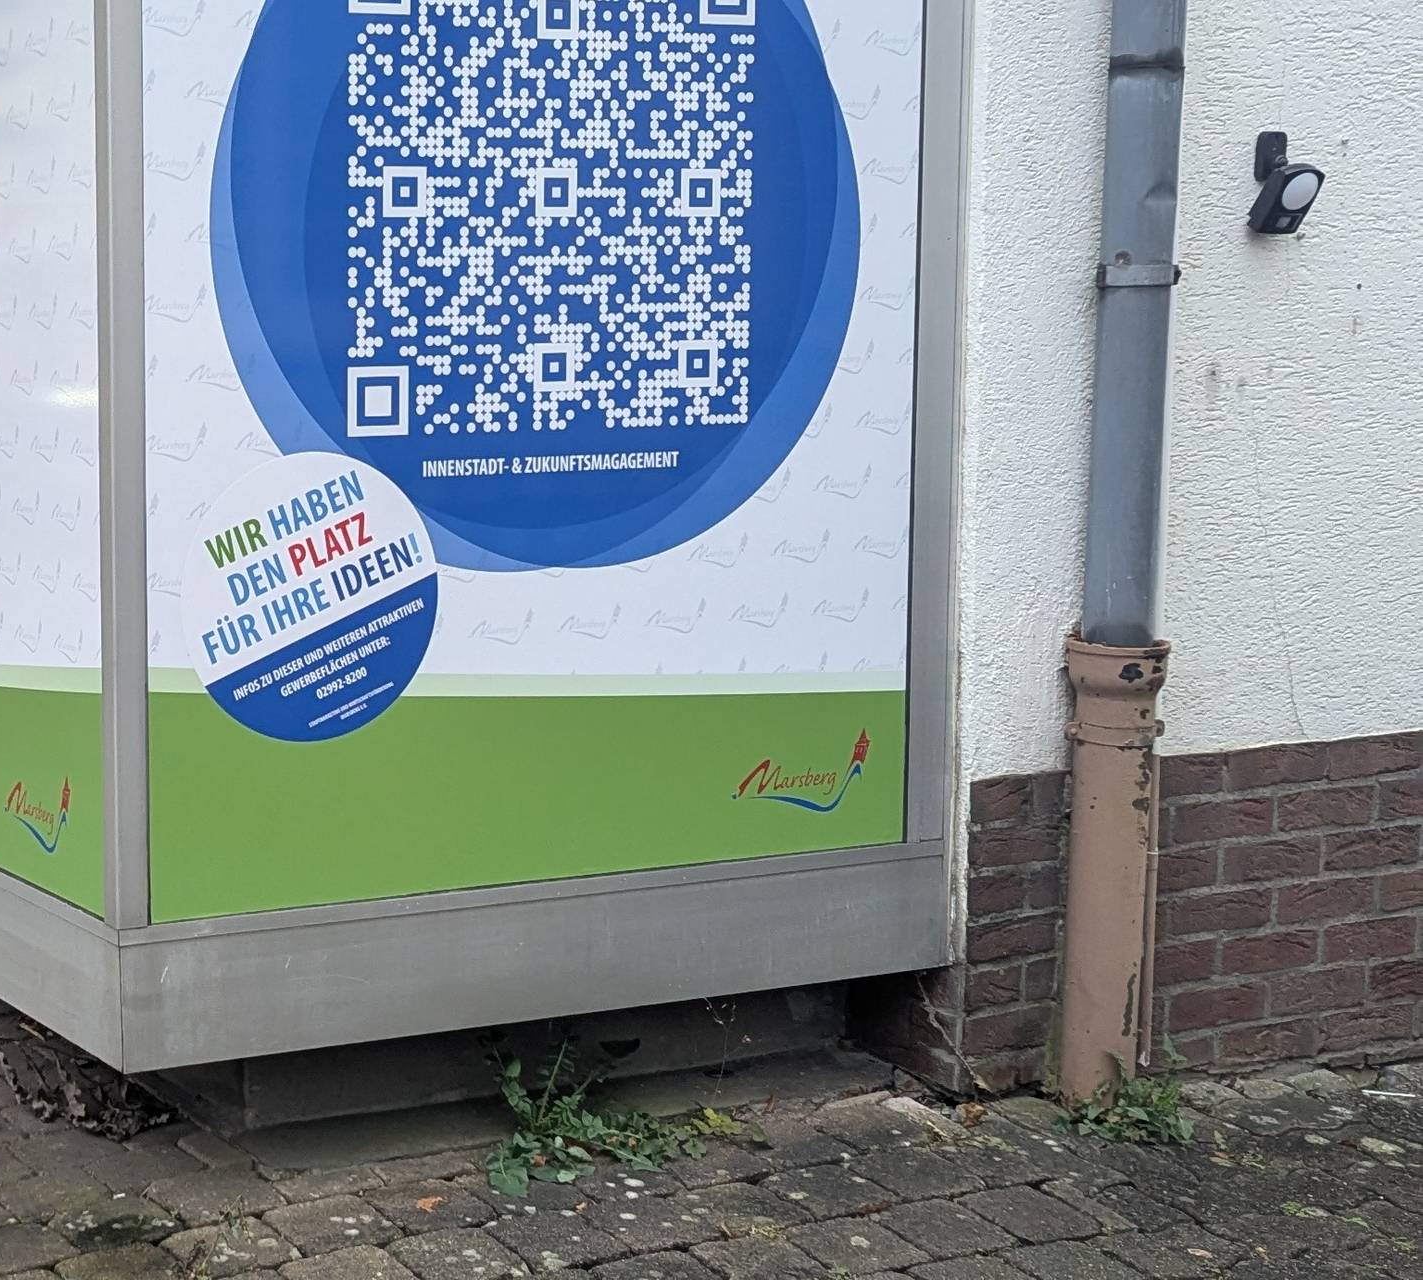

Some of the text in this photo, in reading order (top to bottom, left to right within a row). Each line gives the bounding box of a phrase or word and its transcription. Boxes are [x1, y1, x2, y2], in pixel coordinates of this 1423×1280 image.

[422, 450, 680, 477] INNENSTADT- & ZUKUNFTSMAGAGEMENT
[203, 470, 365, 569] WIR HABEN
[226, 511, 374, 607] DEN PLATZ
[201, 532, 423, 665] FÜR IHRE IDEEN!
[233, 597, 425, 701] INFOS ZU DIESER UND WEITEREN ATTRAKTIVEN
[280, 635, 392, 698] GEWERBEFLÄCHEN UNTER:
[316, 666, 368, 700] 02992-8200
[737, 758, 837, 796] Marsberg
